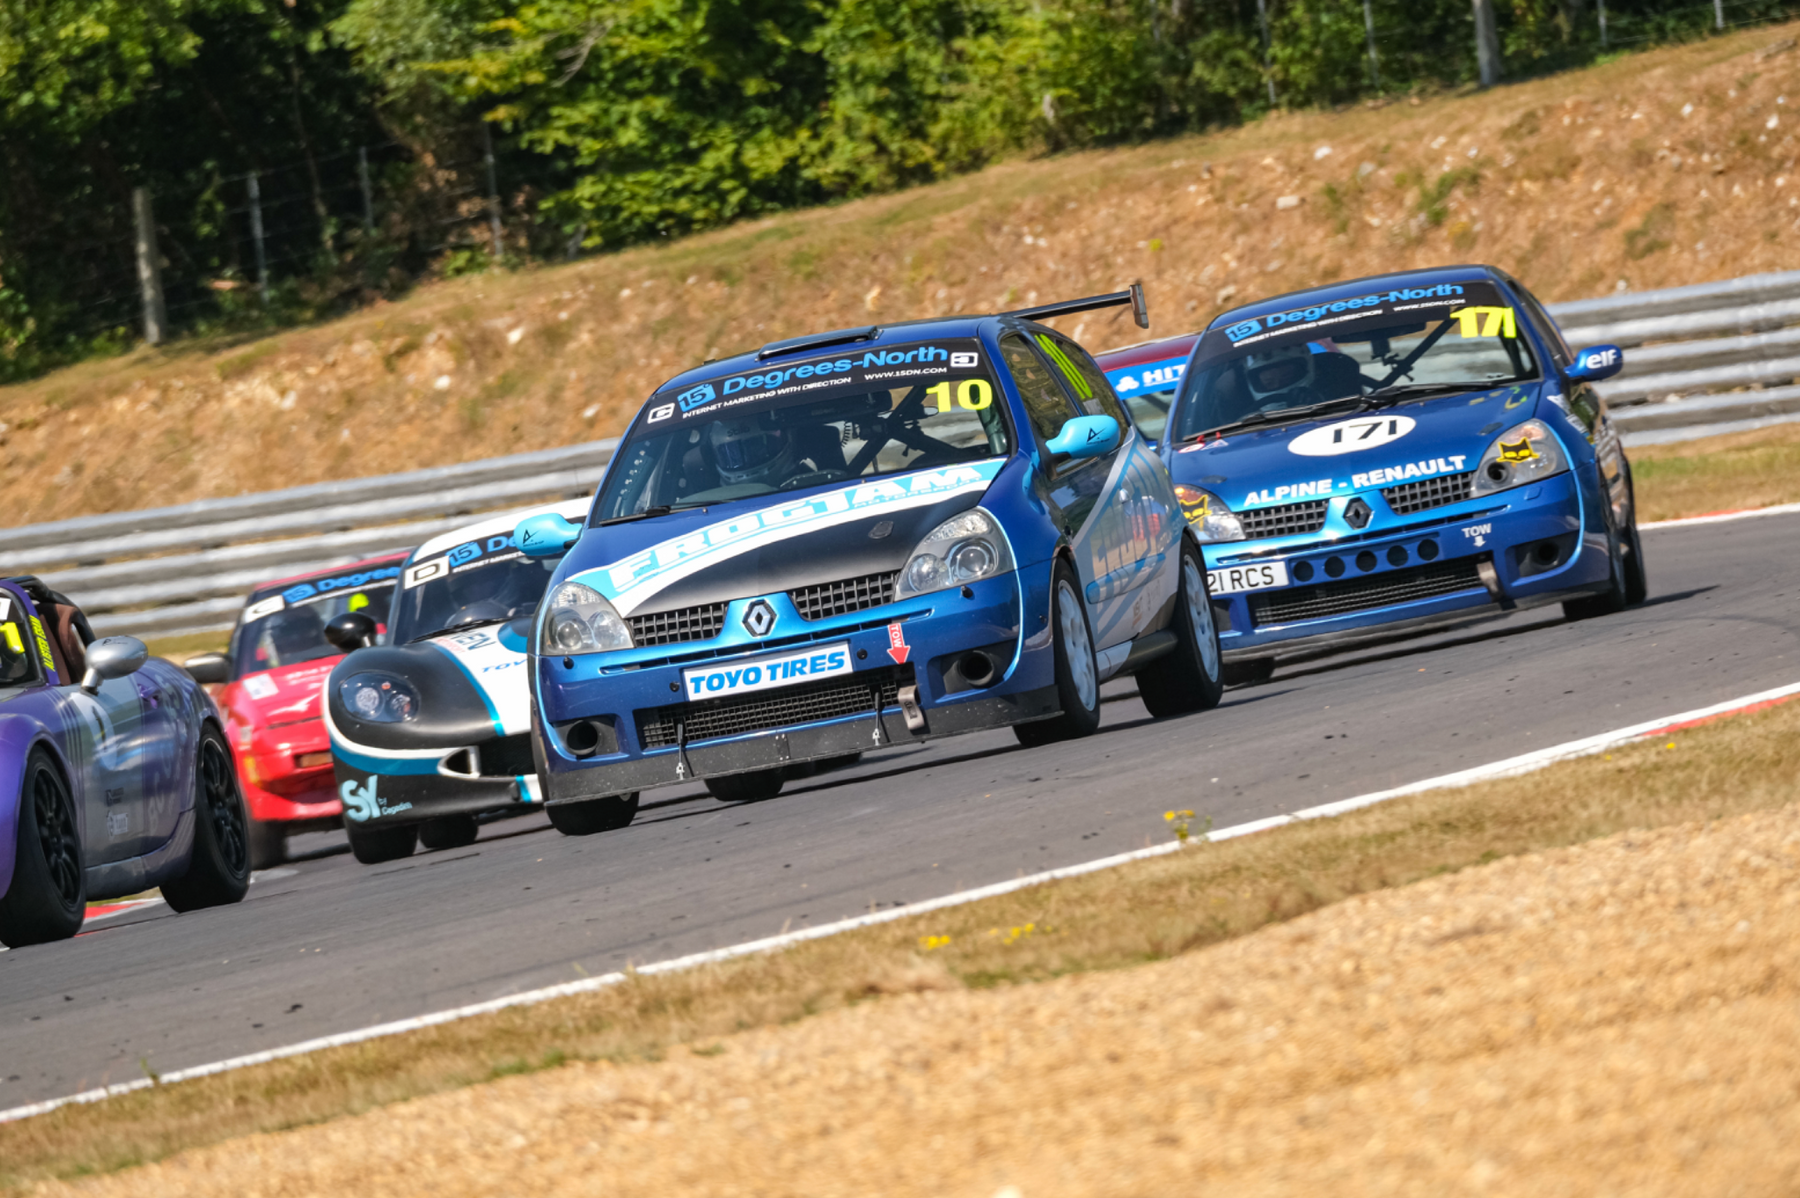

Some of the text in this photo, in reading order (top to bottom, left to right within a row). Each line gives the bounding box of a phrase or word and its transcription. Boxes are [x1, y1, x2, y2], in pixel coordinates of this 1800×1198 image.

[1267, 284, 1464, 328] Degrees-North
[1450, 305, 1516, 338] 171
[723, 347, 948, 395] Degrees-North
[1586, 349, 1617, 369] elf
[683, 367, 947, 419] INTERNET MARKETING WITH DIRECTION WWW.15DN.COM
[926, 379, 993, 413] 10
[1332, 419, 1398, 443] 171
[1243, 478, 1333, 506] ALPINE
[1352, 455, 1466, 488] RENAULT
[609, 466, 982, 589] FROGJAM
[1461, 523, 1492, 539] TOW
[1230, 566, 1274, 590] RCS
[891, 624, 903, 648] TOW
[690, 651, 846, 694] TOYO TIRES
